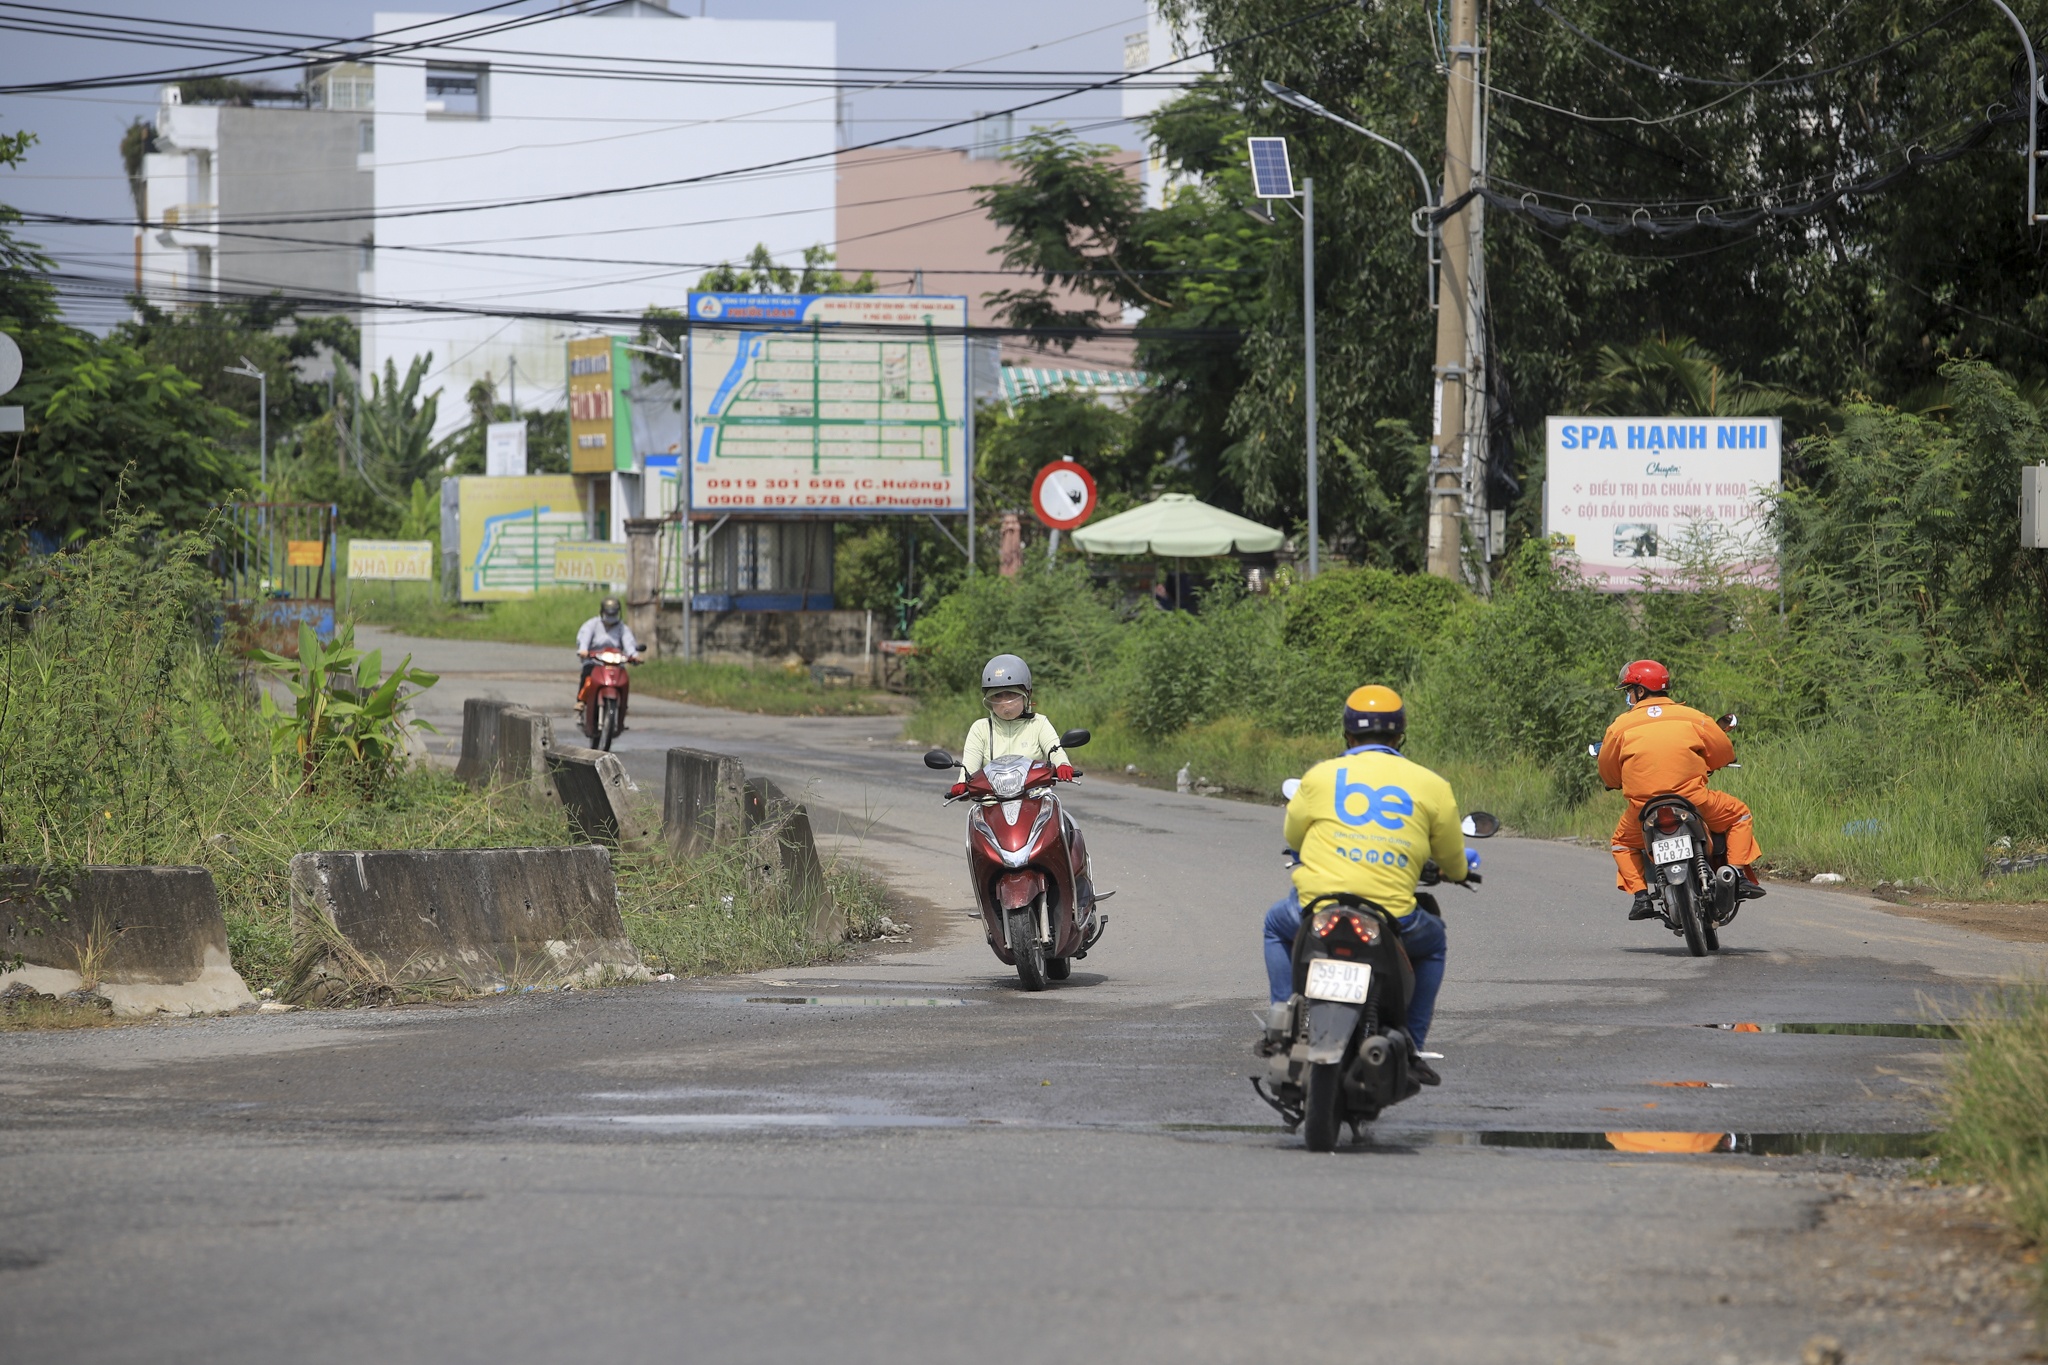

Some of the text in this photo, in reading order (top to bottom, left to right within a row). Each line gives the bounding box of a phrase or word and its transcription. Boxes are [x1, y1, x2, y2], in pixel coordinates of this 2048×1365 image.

[1561, 425, 1768, 455] SPA HẠNH NHI
[707, 479, 757, 489] 0919
[765, 479, 800, 489] 301
[809, 479, 845, 489] 696
[1620, 483, 1638, 499] TRỊ
[1642, 483, 1657, 496] DA
[1705, 483, 1712, 496] Y
[1715, 483, 1747, 496] KHOA
[707, 495, 755, 505] 0908
[763, 495, 798, 505] 897
[806, 495, 841, 505] 578
[1578, 502, 1597, 521] GỘI
[1673, 504, 1701, 518] SINH
[1706, 504, 1714, 518] &
[1718, 504, 1736, 520] TRỊ
[353, 554, 386, 575] NHÀ
[1335, 767, 1413, 830] be
[1658, 838, 1685, 852] 59-X1
[1657, 847, 1691, 862] 148.73
